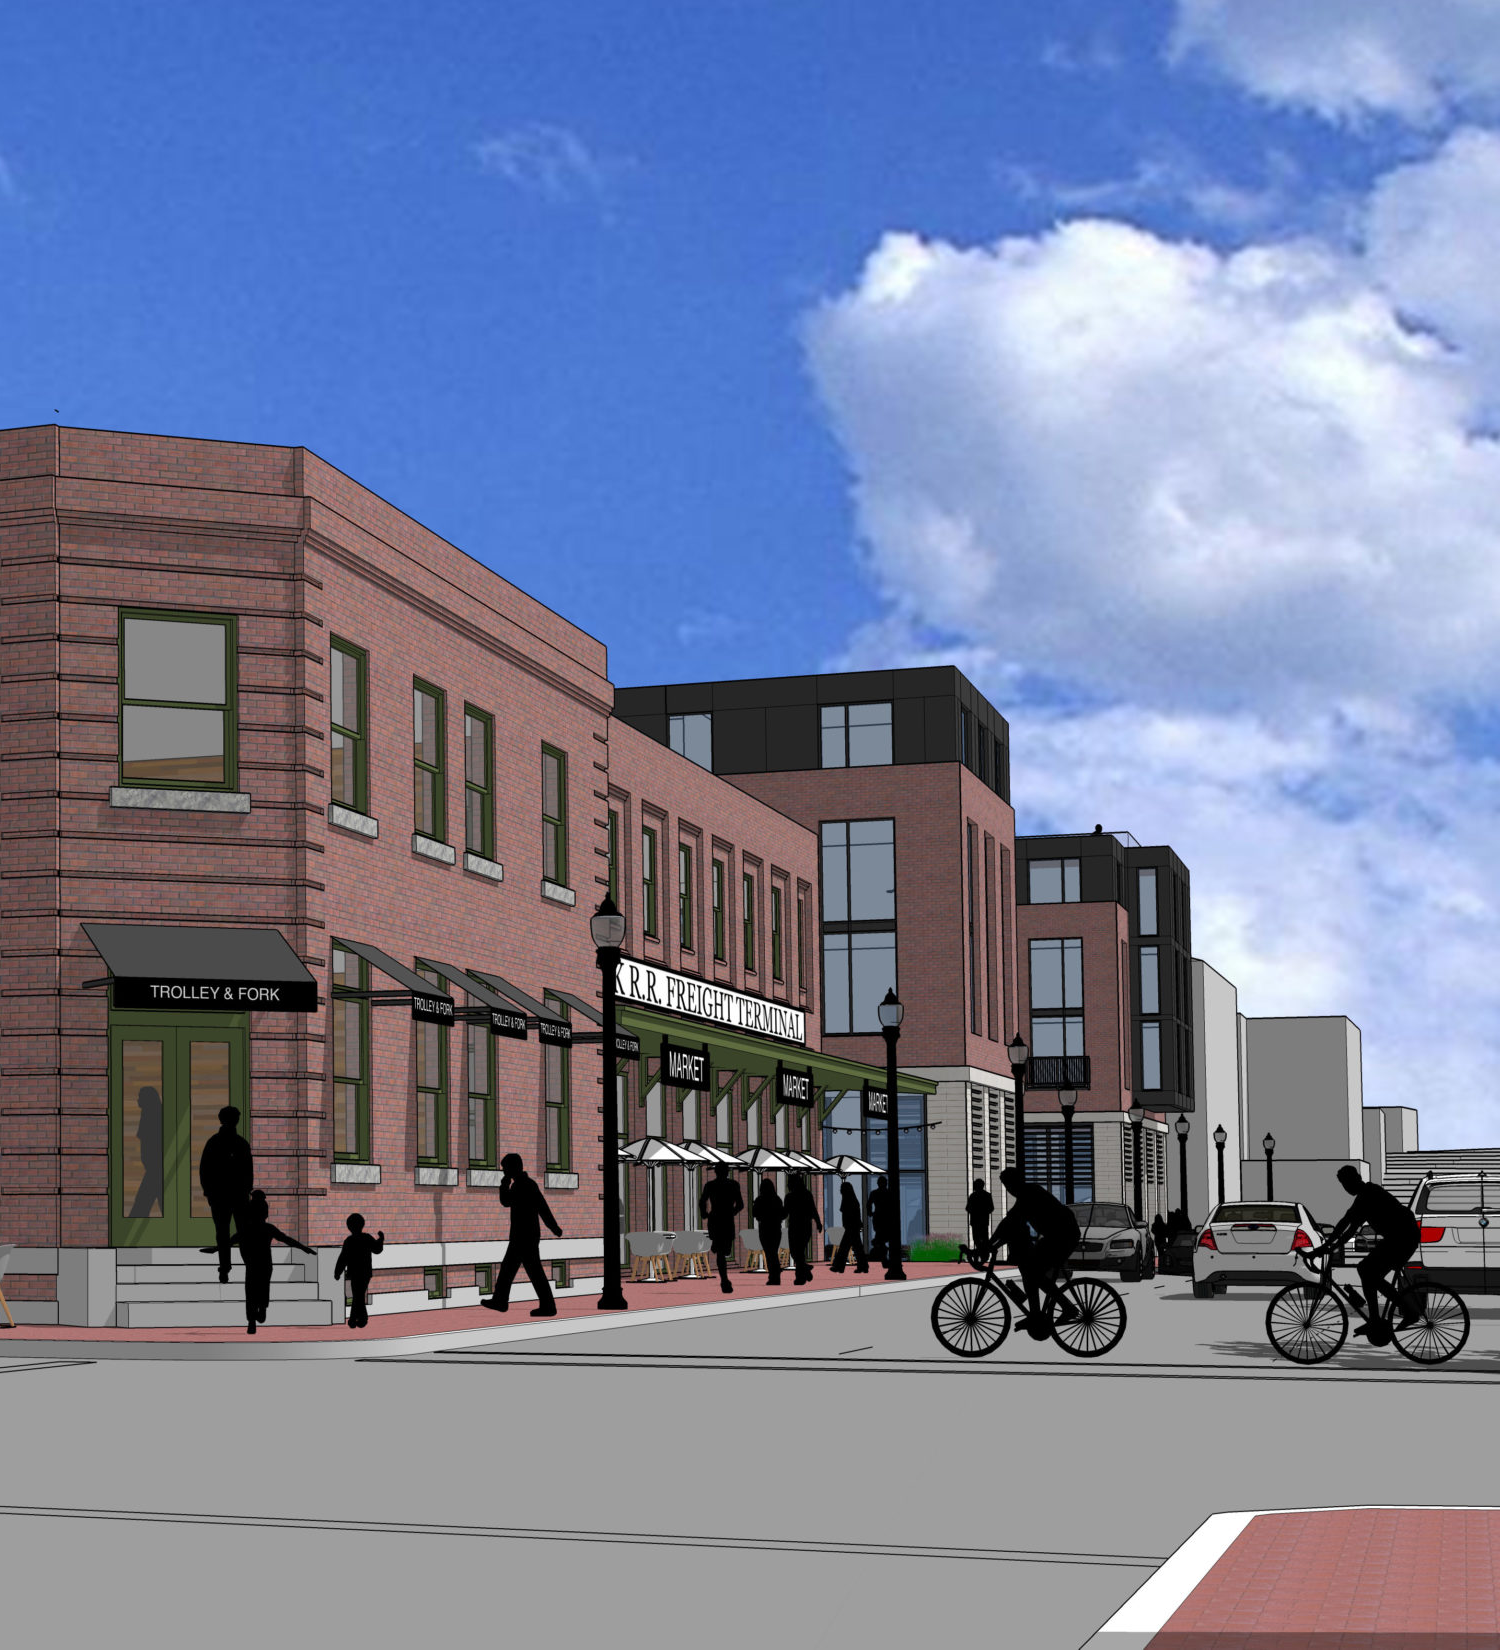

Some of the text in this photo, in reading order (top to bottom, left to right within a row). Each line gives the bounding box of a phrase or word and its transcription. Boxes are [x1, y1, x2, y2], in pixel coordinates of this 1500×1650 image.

[150, 984, 280, 1001] TROLLEY & FORK
[629, 964, 662, 1005] R.R.
[666, 975, 734, 1023] FREIGHT
[736, 997, 803, 1040] TERMINAL
[414, 996, 435, 1013] TROLLEY
[440, 1002, 454, 1016] FORK
[492, 1012, 511, 1028] TROLLEY
[515, 1017, 526, 1031] FORK
[540, 1022, 557, 1037] TROLLEY
[669, 1051, 705, 1082] MARKET
[782, 1074, 810, 1100] MARKET
